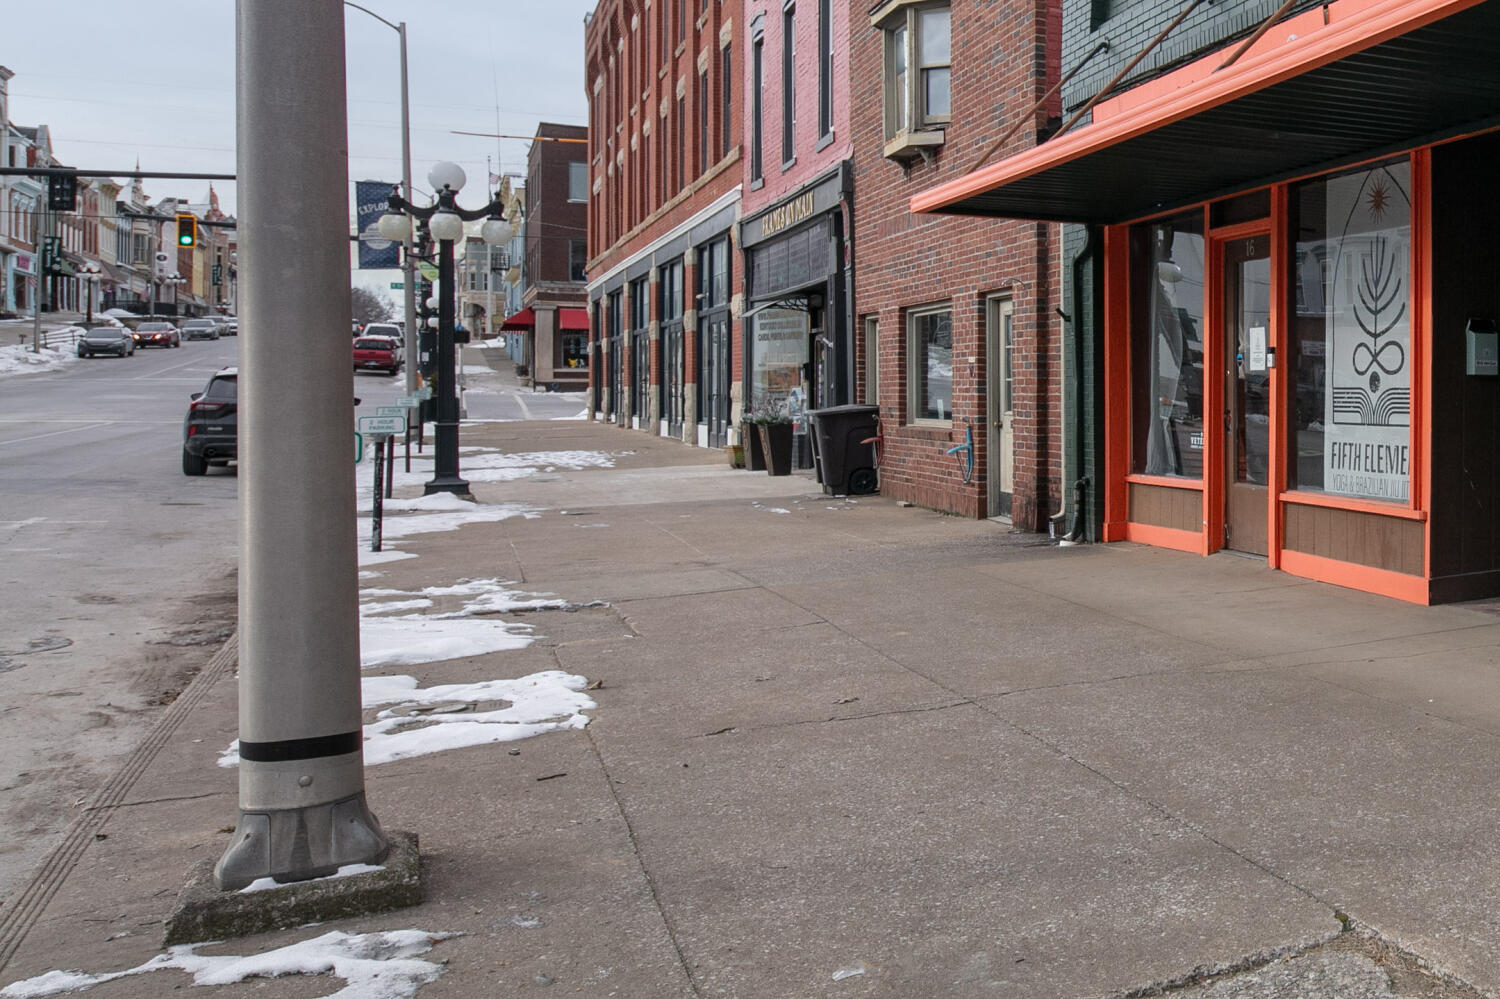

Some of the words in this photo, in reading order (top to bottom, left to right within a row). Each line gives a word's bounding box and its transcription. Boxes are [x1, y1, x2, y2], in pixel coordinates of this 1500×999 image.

[795, 189, 814, 221] MAIN
[1245, 239, 1255, 256] 16
[1331, 442, 1361, 471] FIFTH
[1364, 443, 1410, 475] ELEME
[1333, 474, 1348, 492] YOGA
[1356, 476, 1388, 495] BRAZILIAN
